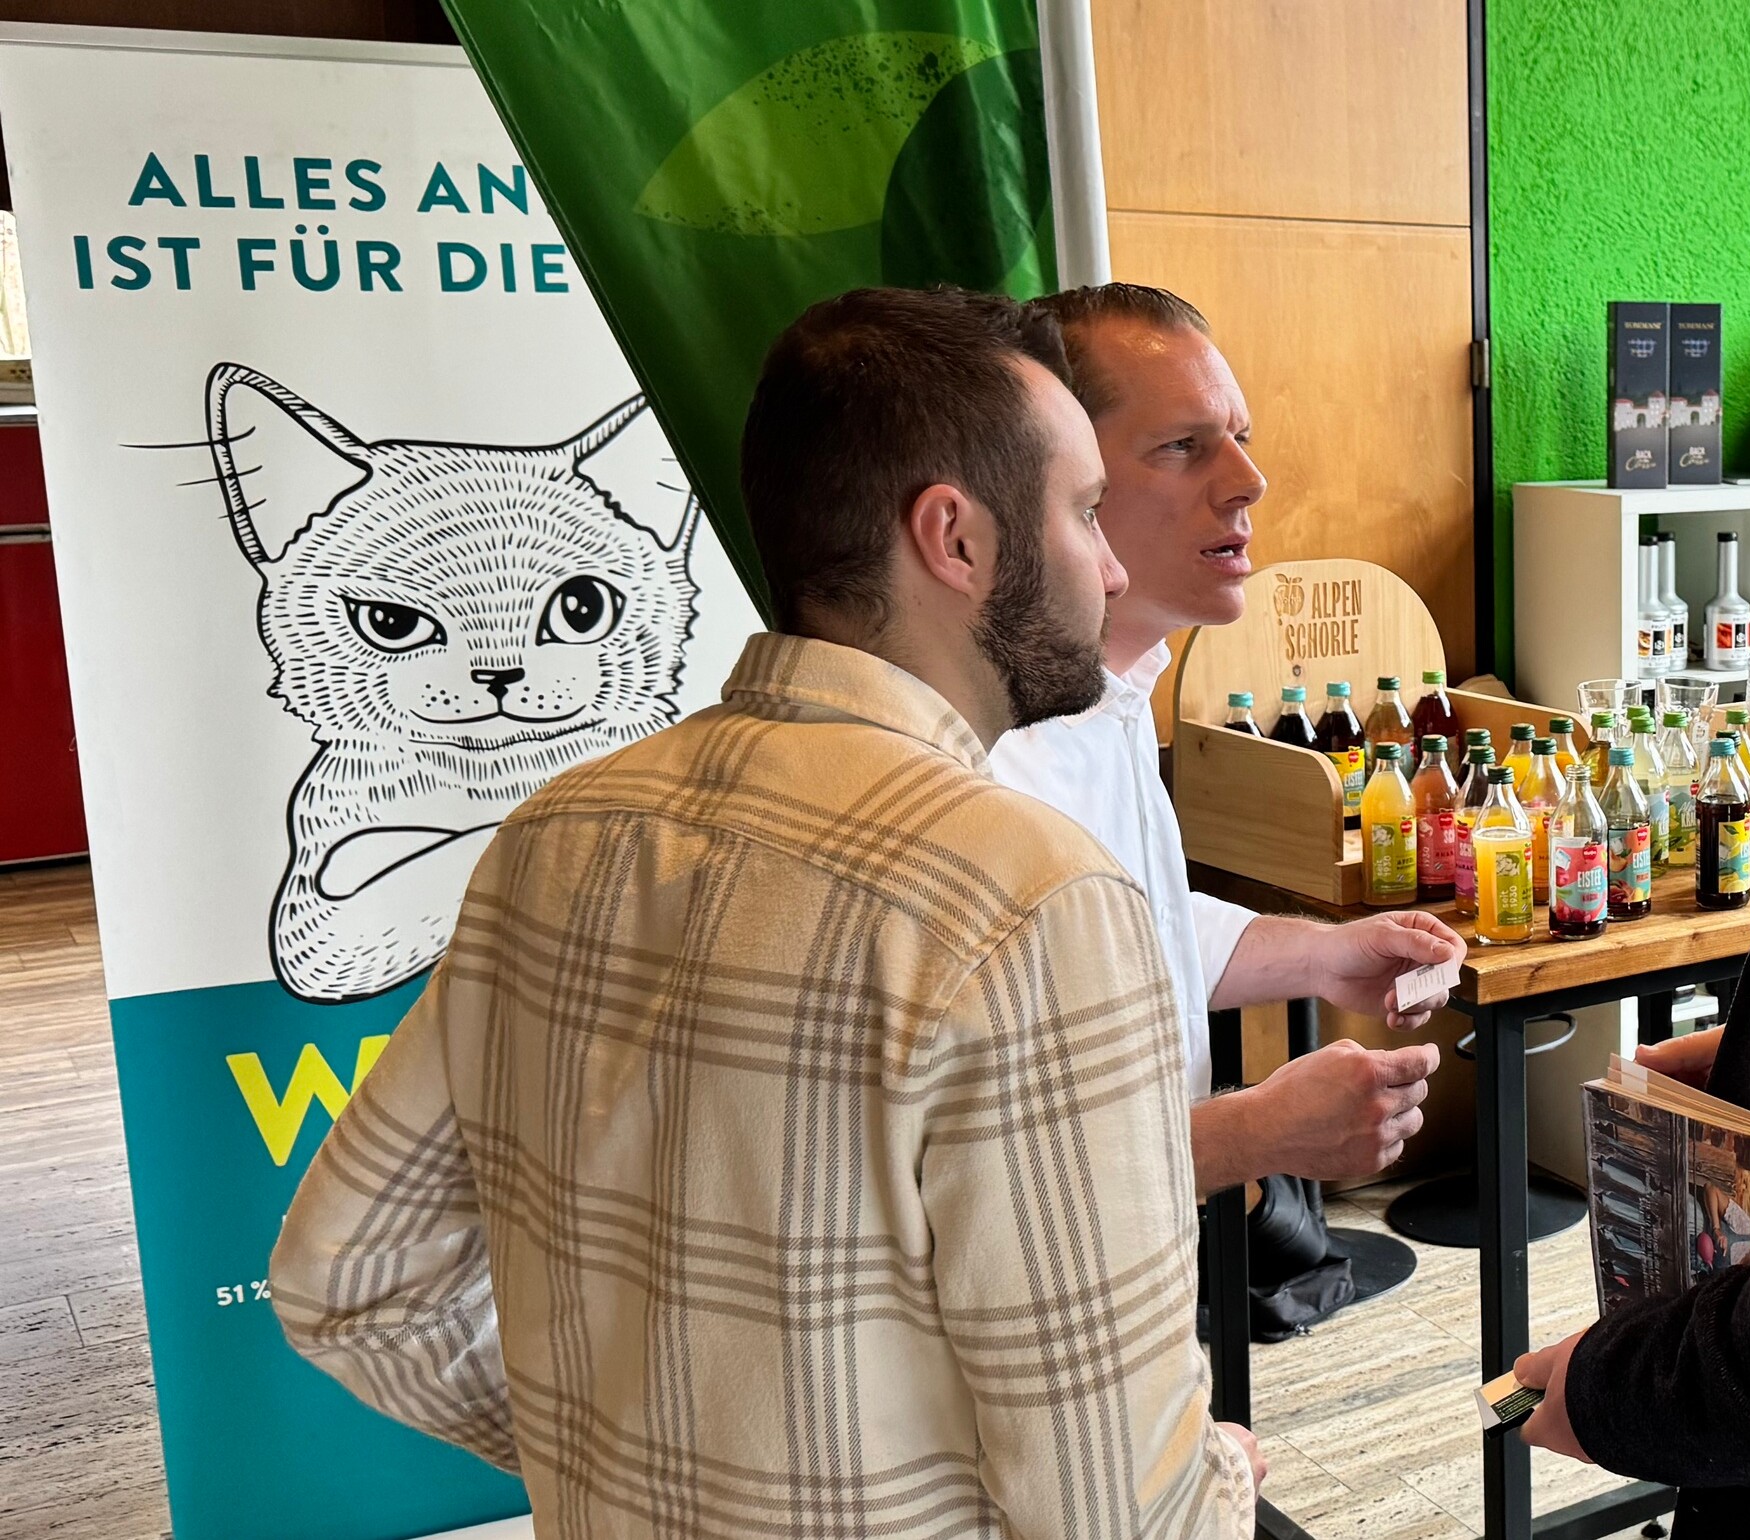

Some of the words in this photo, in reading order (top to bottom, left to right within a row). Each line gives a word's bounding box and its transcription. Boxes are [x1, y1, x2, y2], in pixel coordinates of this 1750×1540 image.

[128, 152, 385, 212] ALLES
[417, 162, 551, 215] AN
[73, 235, 201, 291] IST
[238, 224, 405, 293] FÜR
[438, 240, 570, 293] DIE
[1311, 579, 1362, 619] ALPEN
[1284, 618, 1359, 661] SCHORLE
[1510, 885, 1518, 907] 1930
[216, 1284, 244, 1306] 51
[251, 1279, 272, 1302] %
